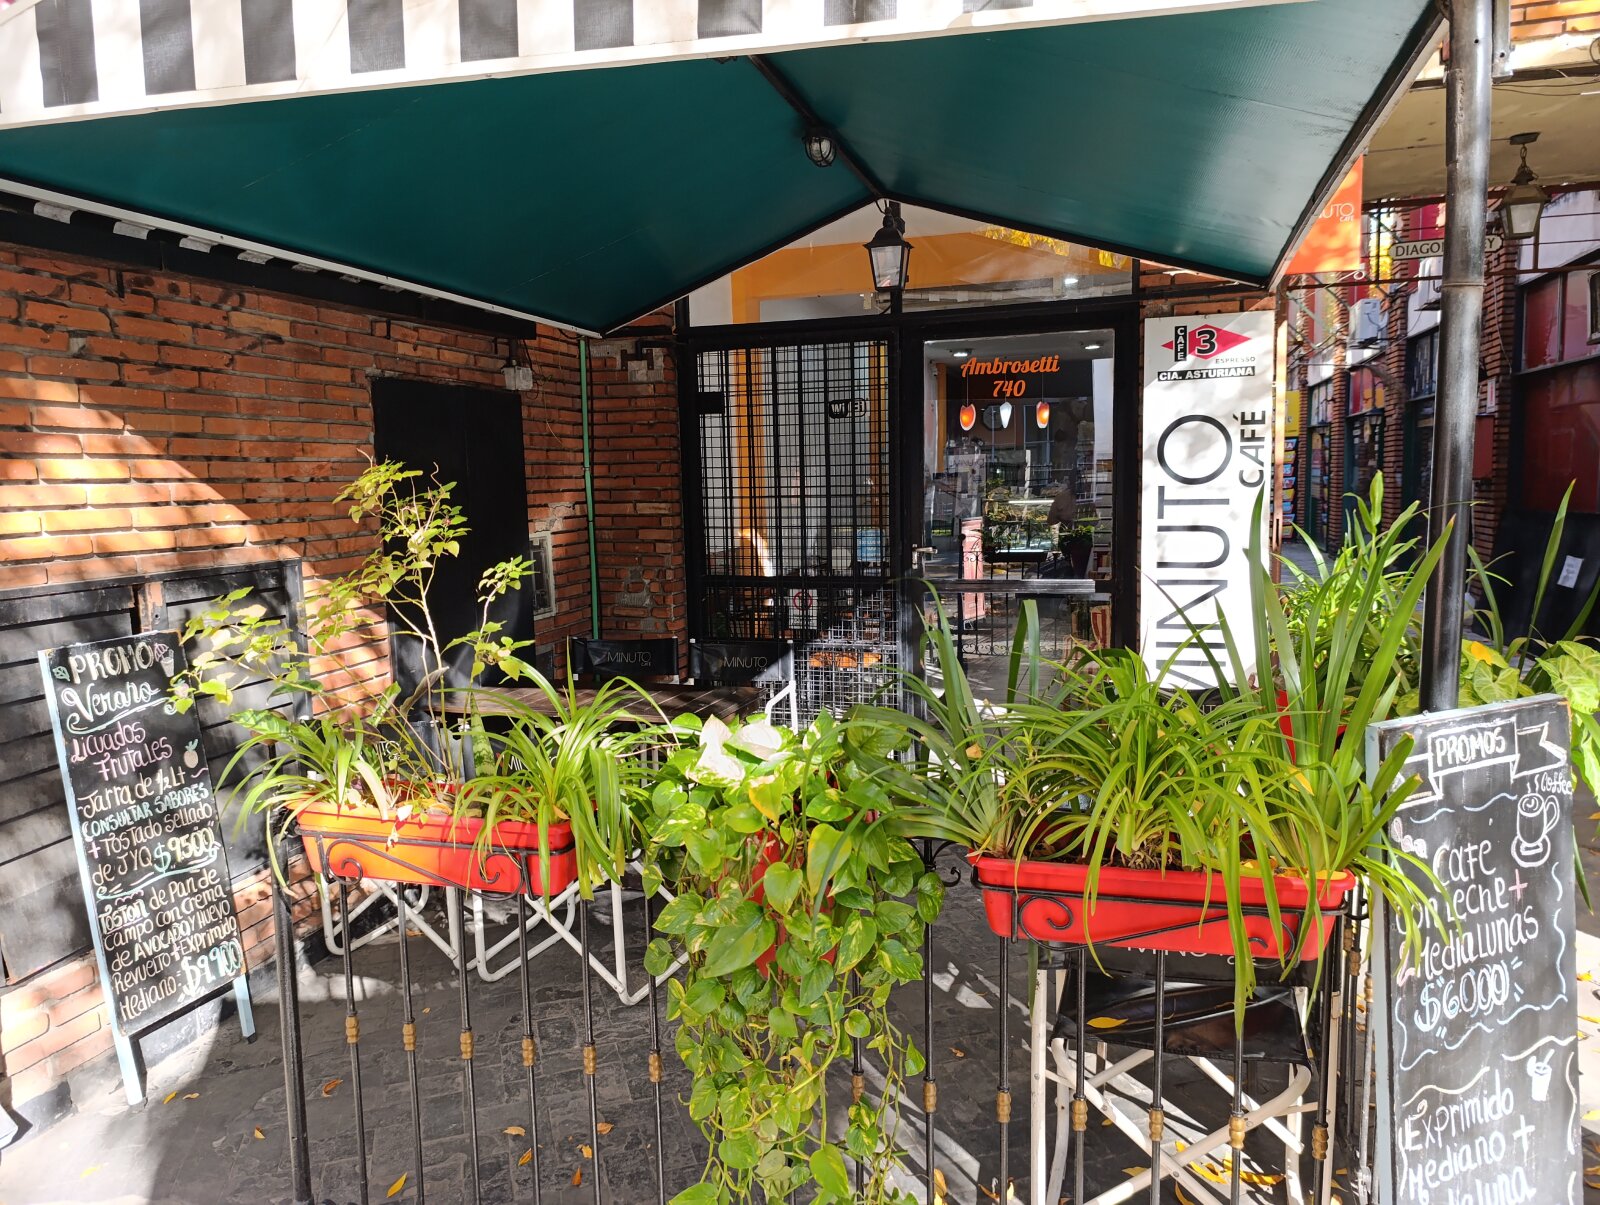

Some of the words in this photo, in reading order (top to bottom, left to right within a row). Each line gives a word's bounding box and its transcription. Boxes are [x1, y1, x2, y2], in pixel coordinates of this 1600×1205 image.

[1319, 203, 1354, 218] UTO
[1395, 241, 1444, 256] DIAGO
[1176, 327, 1185, 360] CAFE
[1195, 329, 1217, 355] 3
[961, 354, 1060, 378] Ambrosetti
[1215, 356, 1256, 364] ESPRESSO
[1158, 371, 1182, 381] CIA.
[1185, 367, 1254, 379] ASTURIANA
[992, 379, 1026, 397] 740
[1233, 410, 1266, 488] CAFÉ
[68, 641, 155, 685] PROMO
[607, 651, 651, 663] MINUTO
[723, 656, 768, 669] MINUTO
[61, 681, 160, 723] Verano
[1435, 727, 1506, 768] PROMOS
[135, 773, 154, 799] de
[82, 802, 153, 842] CONSULTAR
[154, 782, 209, 813] SABORES
[92, 863, 115, 886] de
[149, 886, 168, 910] de
[198, 868, 220, 889] de
[111, 950, 134, 971] de
[135, 921, 190, 961] AVOCADO
